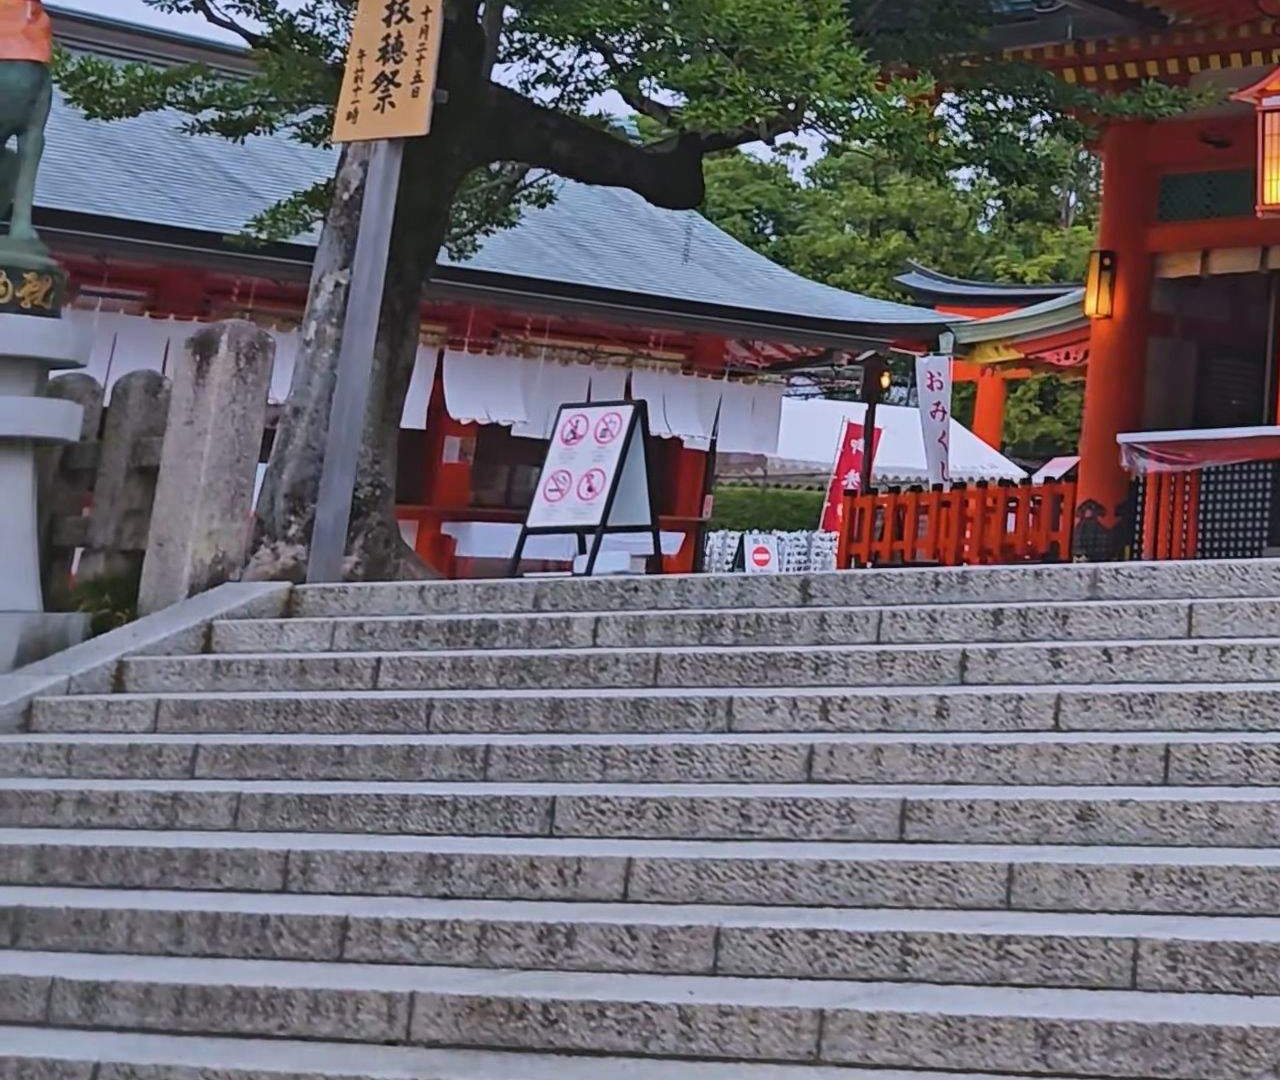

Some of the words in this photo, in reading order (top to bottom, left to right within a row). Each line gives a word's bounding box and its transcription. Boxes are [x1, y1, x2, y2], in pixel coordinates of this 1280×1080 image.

[409, 5, 433, 99] 十月二十五日
